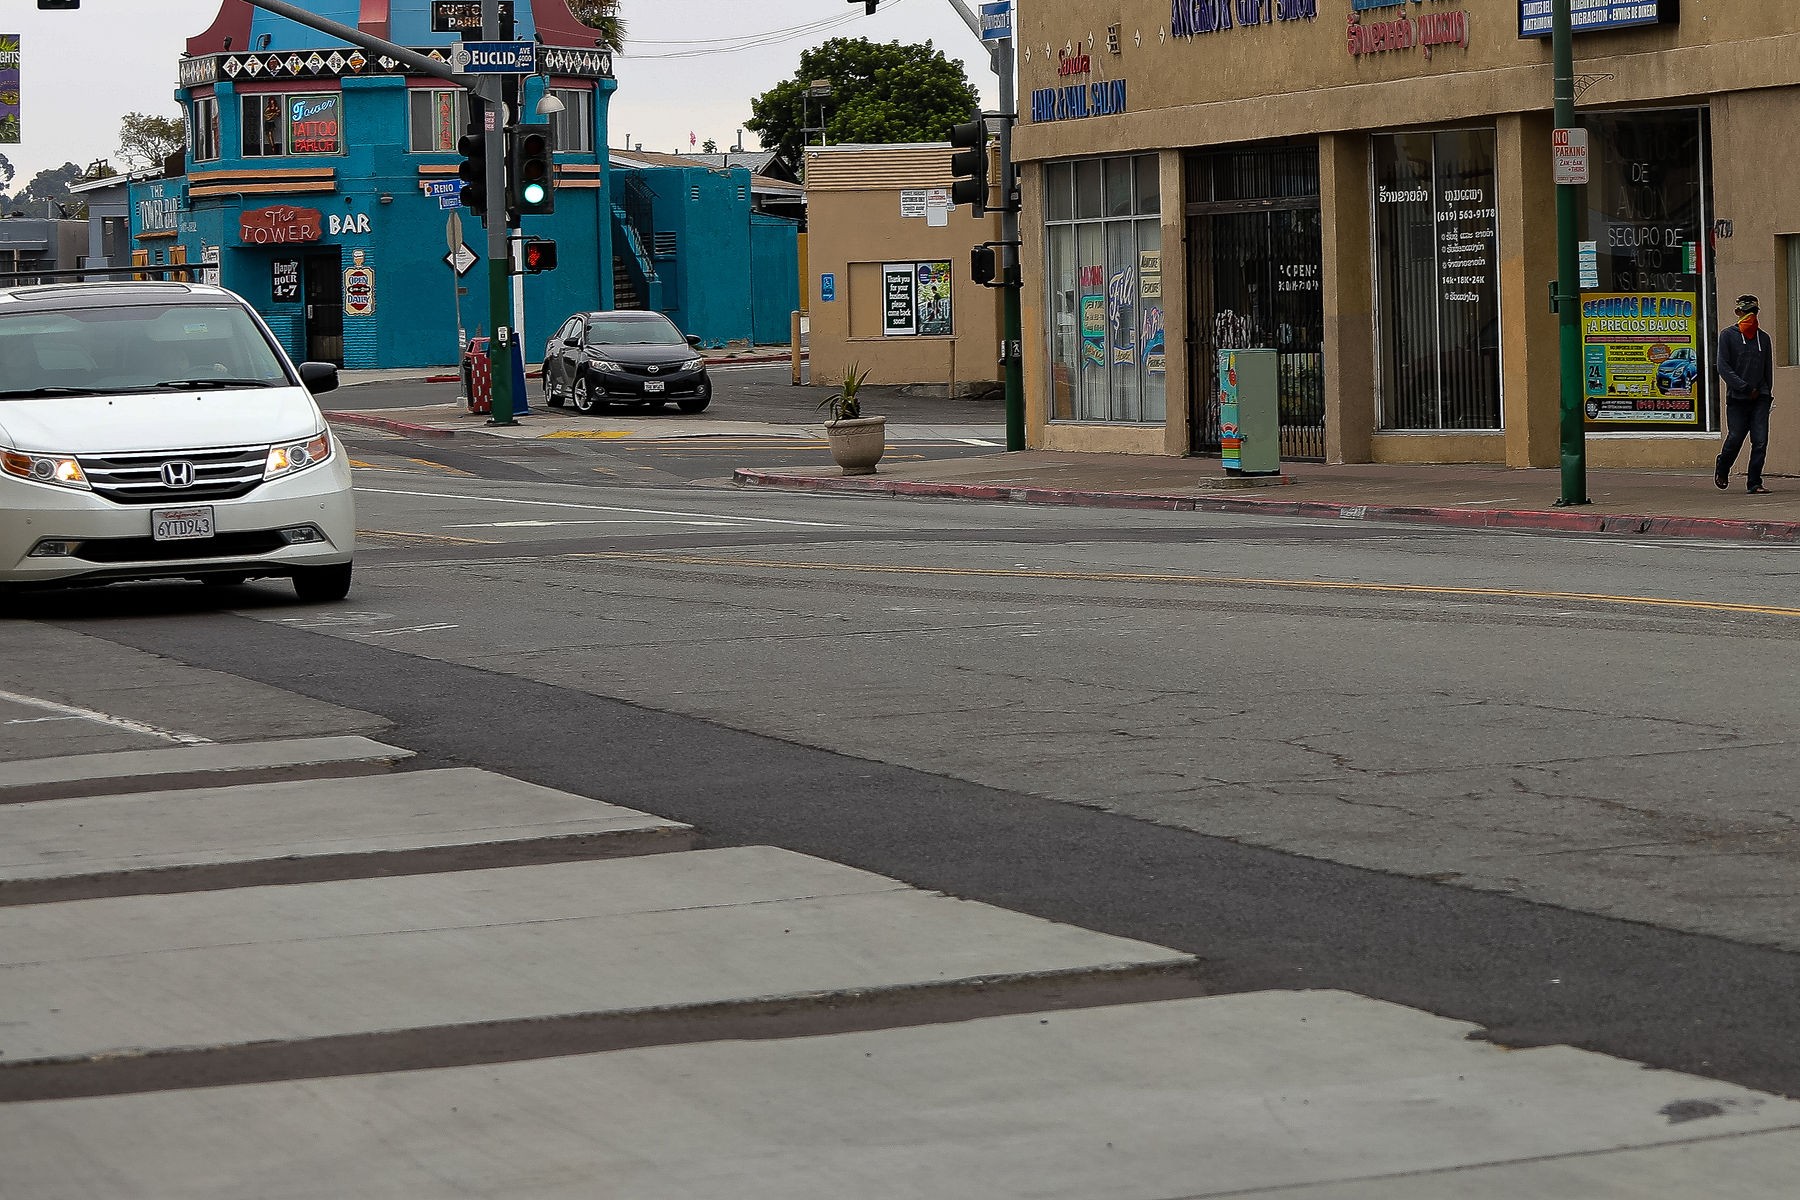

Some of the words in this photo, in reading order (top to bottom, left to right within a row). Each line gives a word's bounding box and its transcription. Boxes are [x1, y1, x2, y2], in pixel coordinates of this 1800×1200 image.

[1571, 9, 1607, 25] MIGRACION
[1613, 5, 1630, 20] ENVIOS
[1638, 3, 1656, 18] DINERO
[472, 50, 516, 65] EUCLID
[519, 47, 531, 55] AVE
[1058, 41, 1091, 77] Sandra
[1031, 88, 1056, 123] HAIR
[1065, 85, 1089, 119] NAIL
[1091, 79, 1127, 116] SALON
[292, 98, 337, 121] Tower
[292, 121, 337, 136] TATTOO
[1555, 131, 1568, 144] NO
[295, 139, 334, 152] PARLOR
[1555, 146, 1586, 157] PARKING
[1632, 163, 1649, 183] DE
[150, 185, 164, 198] THE
[433, 184, 454, 194] RENO
[264, 208, 295, 226] The
[1437, 210, 1457, 222] (619)
[242, 224, 316, 244] TOWER
[328, 213, 371, 235] BAR
[1608, 227, 1660, 247] SEGURO
[1665, 228, 1684, 248] DE
[1630, 248, 1662, 268] AUTO
[274, 275, 297, 286] HOUR
[349, 276, 368, 284] OPEN
[887, 275, 900, 283] Thank
[901, 276, 910, 284] you
[273, 285, 297, 296] 4-7
[347, 296, 369, 304] DAILY
[1583, 297, 1639, 318] SEGUROS
[1641, 297, 1657, 318] DE
[1659, 297, 1693, 318] AUTO
[1600, 319, 1646, 332] PRECIOS
[1649, 319, 1688, 332] BAJOS!
[158, 519, 210, 536] 6YTD943
